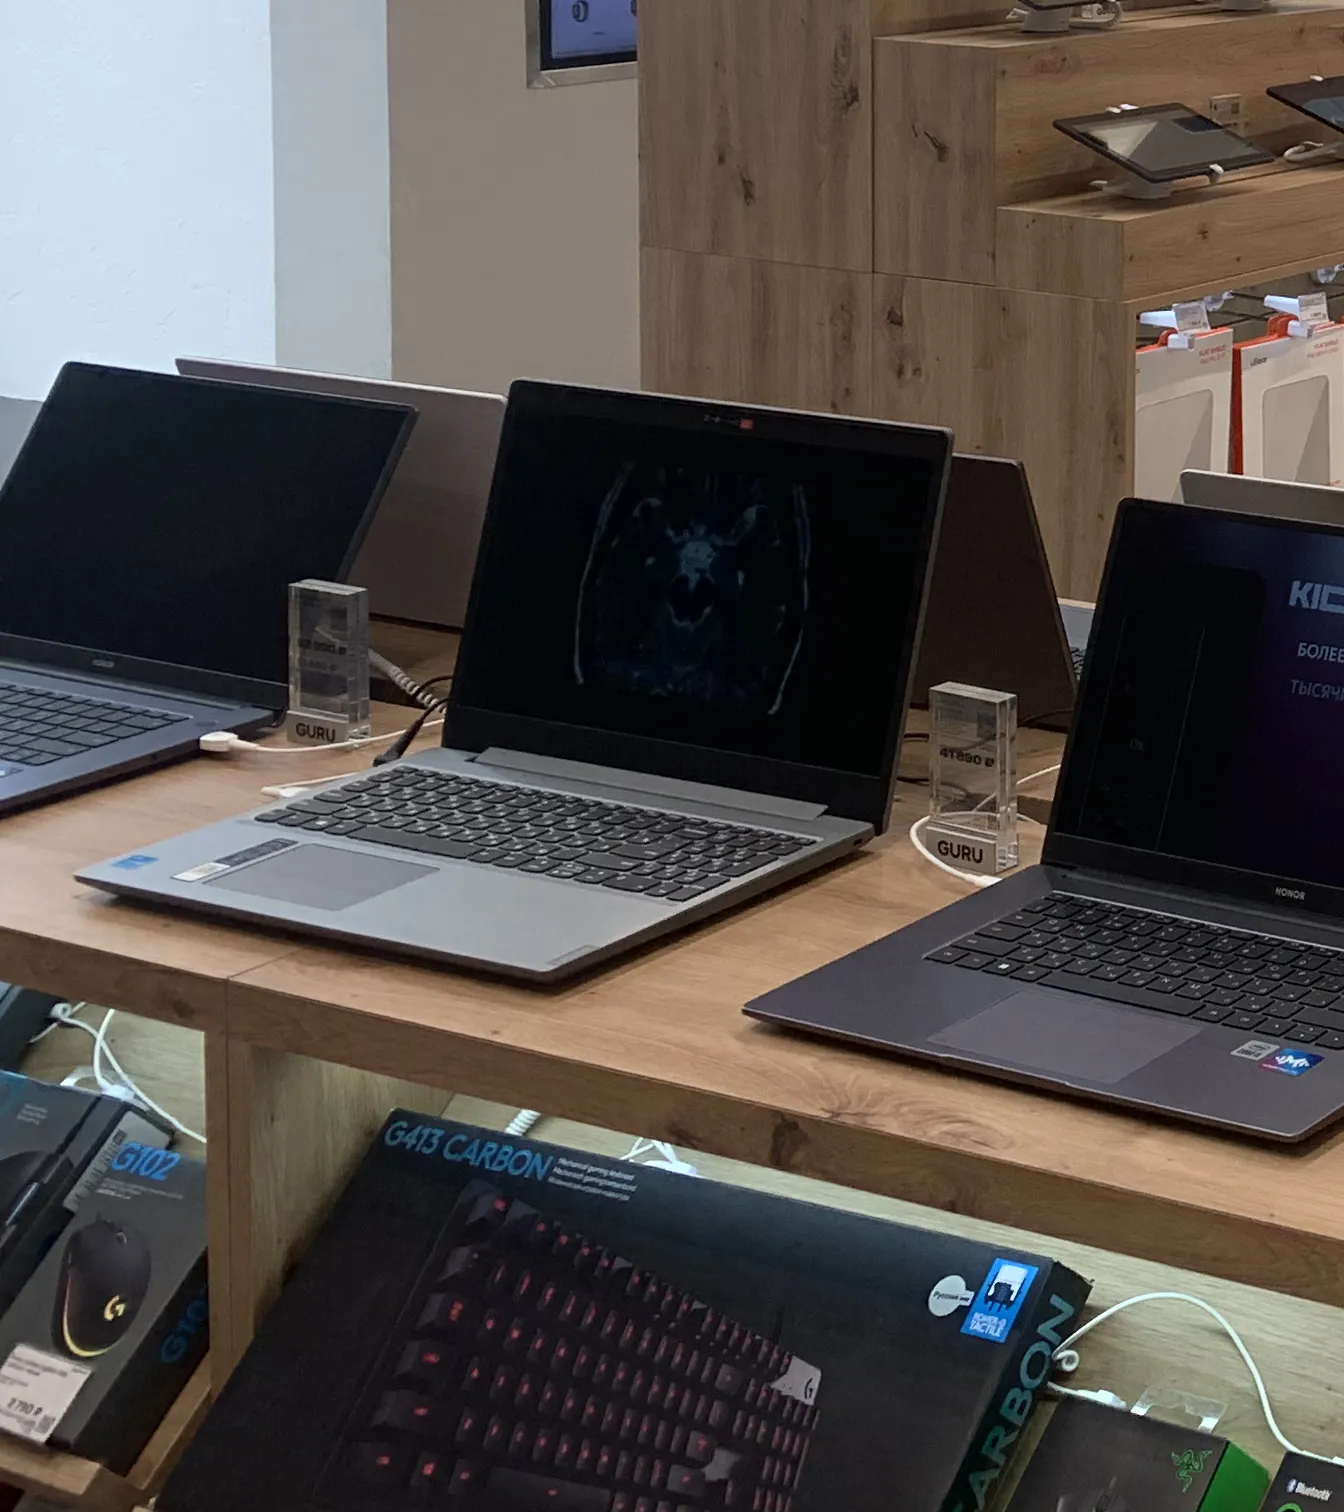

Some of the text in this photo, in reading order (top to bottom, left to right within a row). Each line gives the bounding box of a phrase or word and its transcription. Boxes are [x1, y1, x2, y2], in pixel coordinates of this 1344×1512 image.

[295, 722, 336, 743] GURU
[937, 839, 984, 865] GURU
[1274, 886, 1306, 901] HONOR
[112, 1140, 181, 1181] G102
[384, 1120, 445, 1155] G413
[442, 1134, 553, 1181] CARBON
[161, 1298, 209, 1364] G10
[969, 1319, 1002, 1338] TACTILE
[951, 1293, 1076, 1512] ARBON
[1295, 1481, 1333, 1501] Bluetooth
